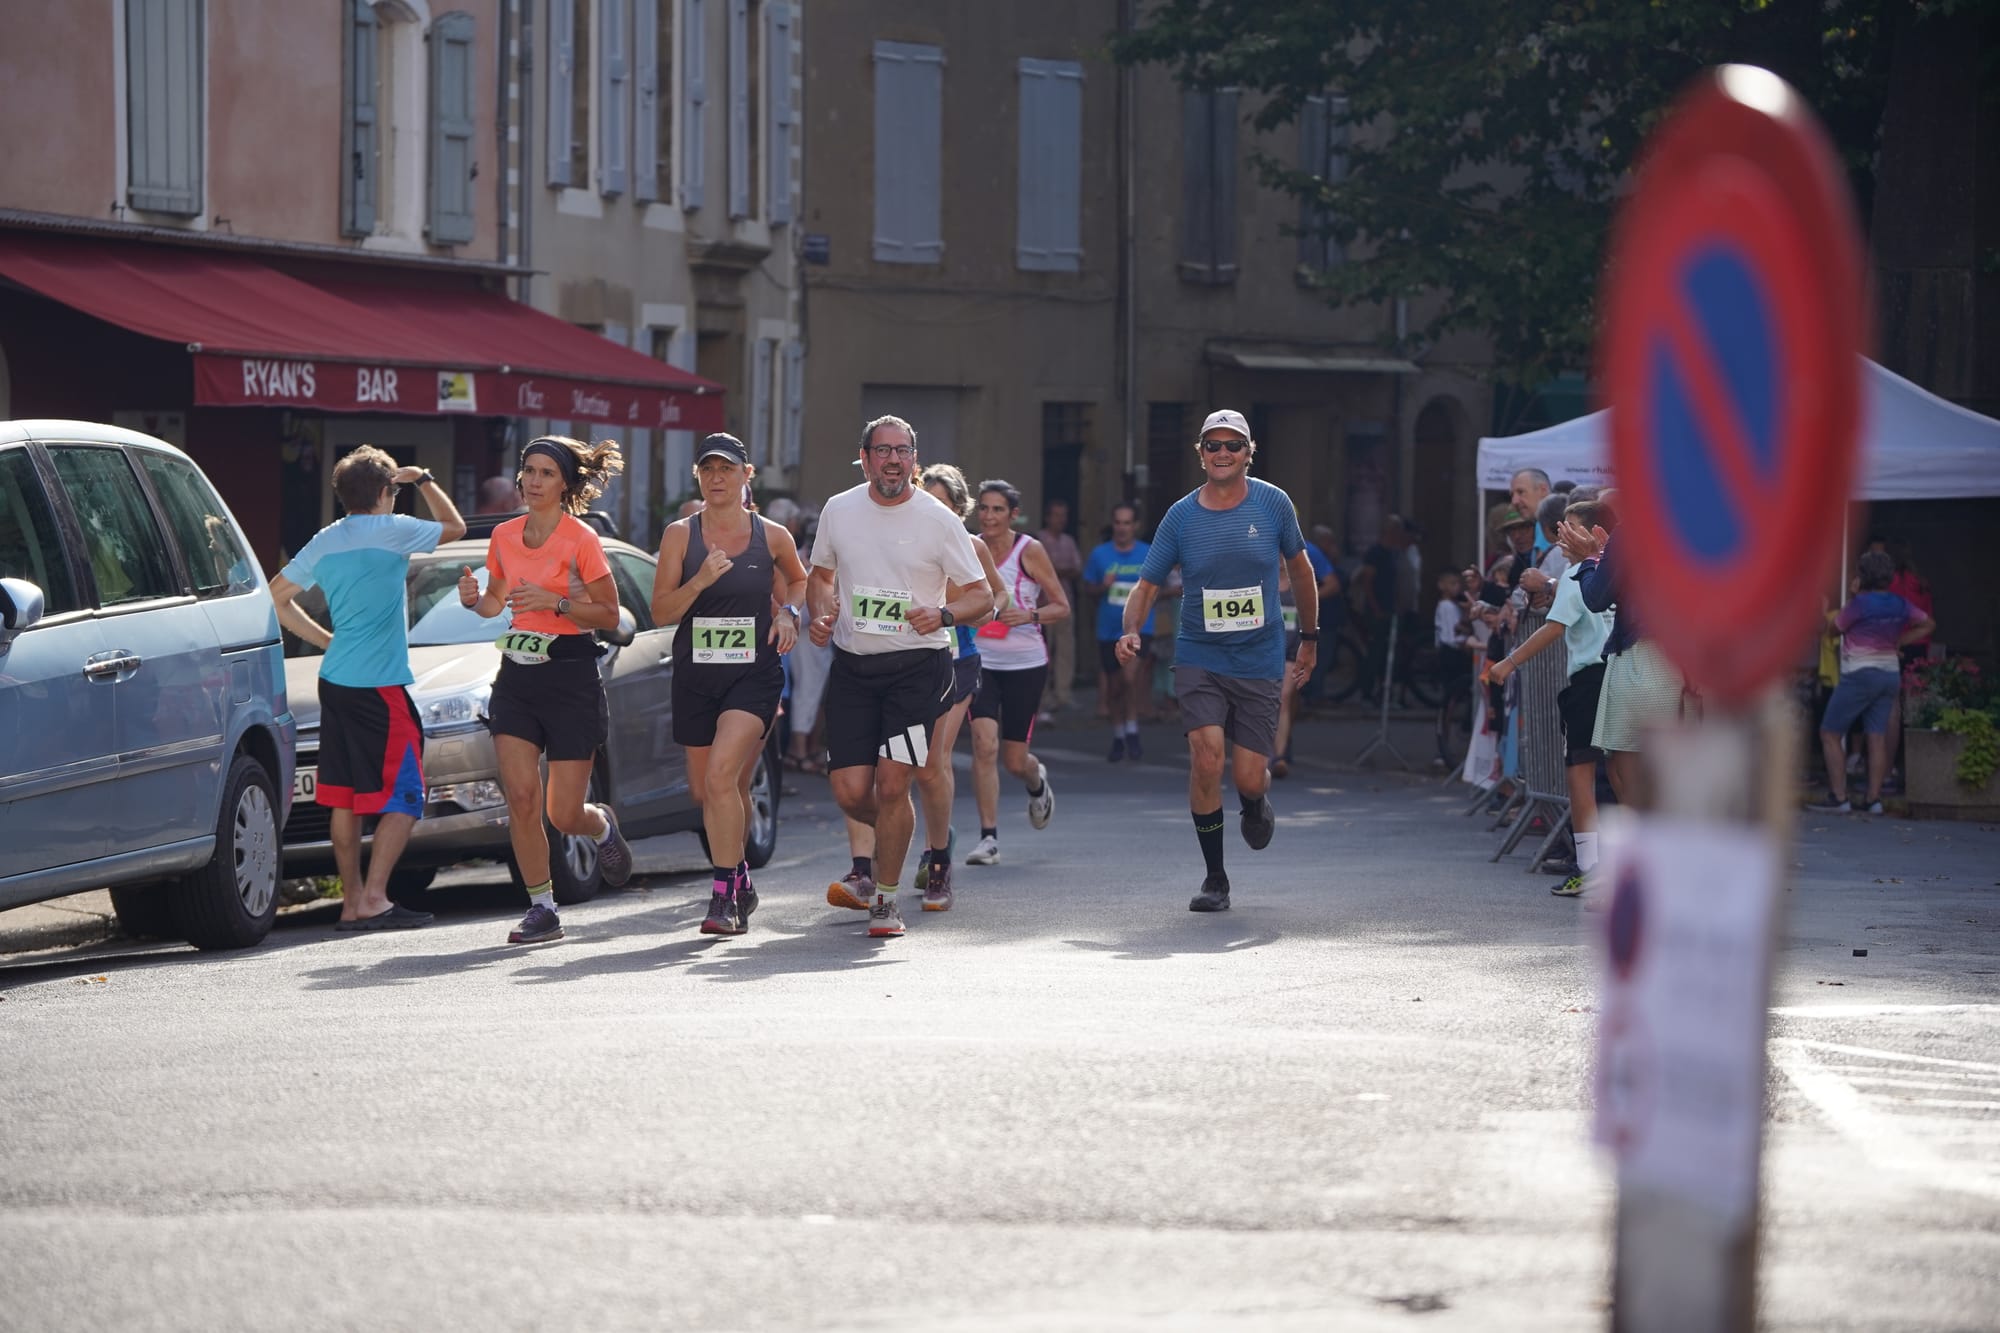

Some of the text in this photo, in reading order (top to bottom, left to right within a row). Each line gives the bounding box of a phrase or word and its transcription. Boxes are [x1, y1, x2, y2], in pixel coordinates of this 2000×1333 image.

[243, 360, 316, 398] RYAN'S
[356, 368, 398, 402] BAR
[859, 599, 901, 620] 174
[1212, 599, 1255, 618] 194
[506, 634, 543, 652] 173
[702, 629, 746, 648] 172
